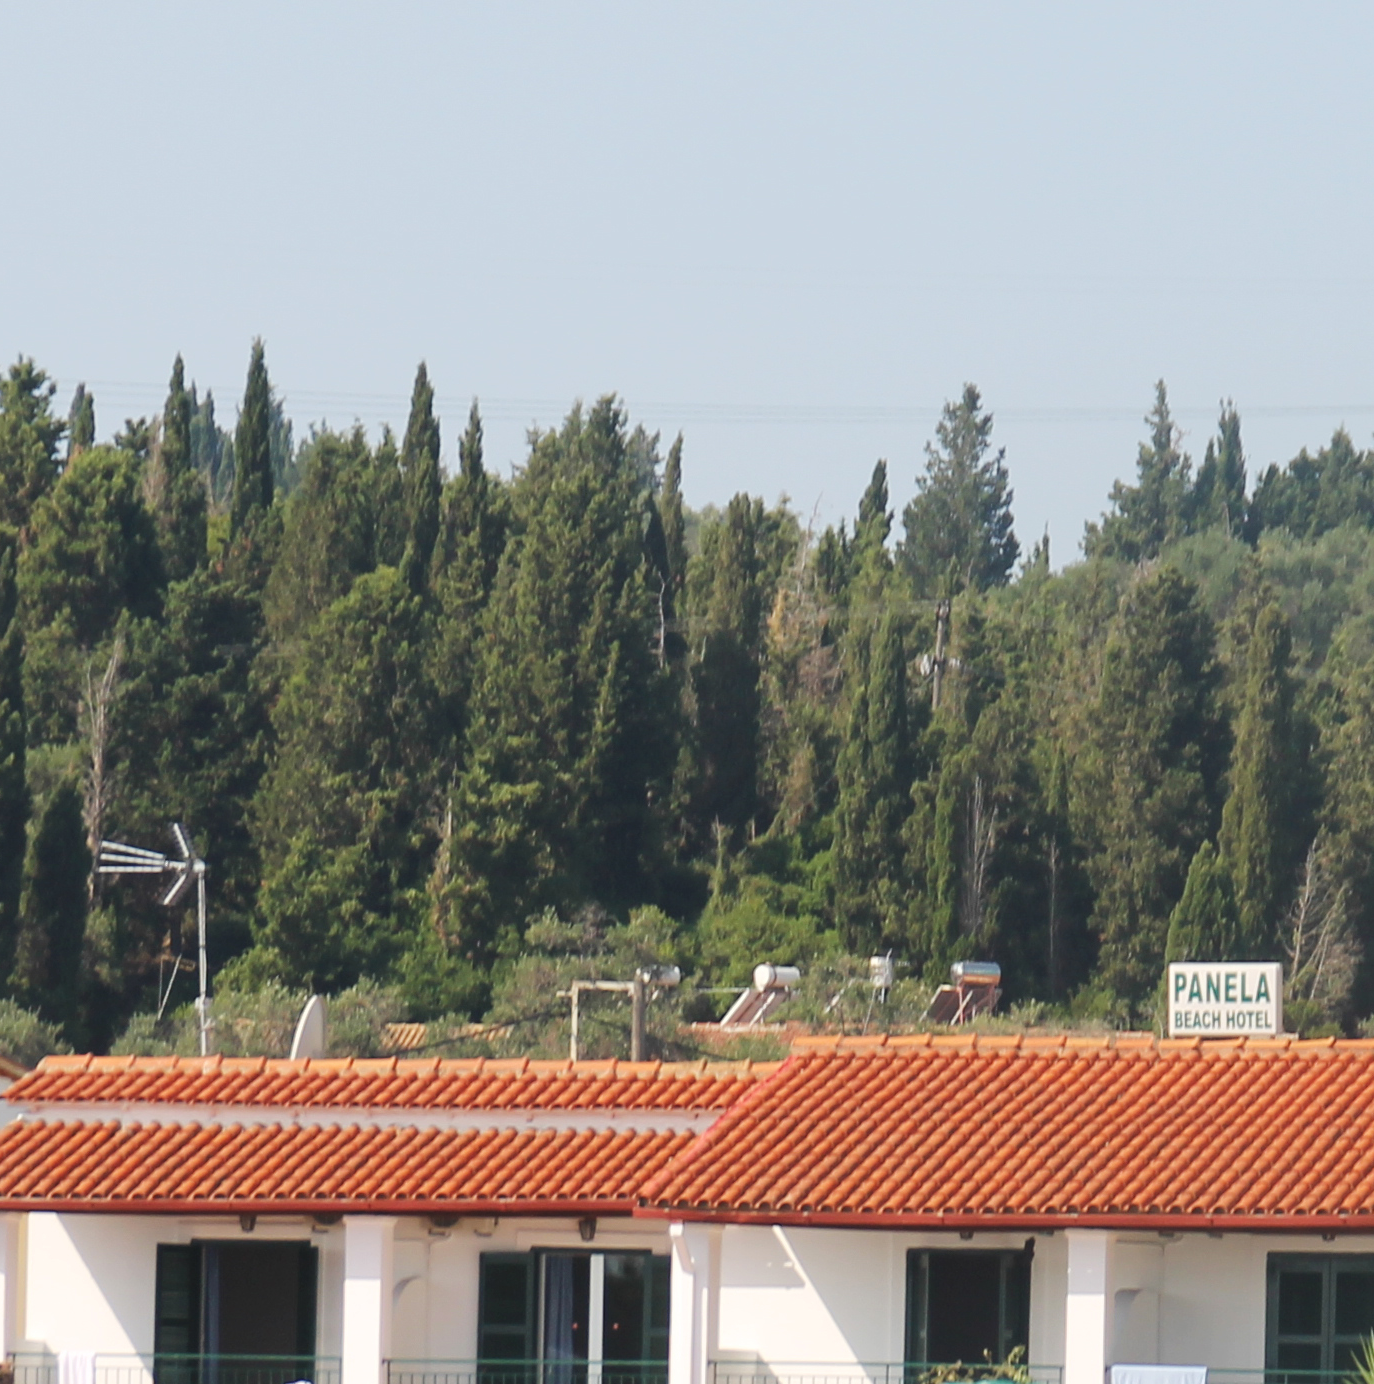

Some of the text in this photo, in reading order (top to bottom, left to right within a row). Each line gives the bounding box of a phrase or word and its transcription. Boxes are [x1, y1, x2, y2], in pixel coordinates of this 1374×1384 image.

[1174, 972, 1270, 1002] PANELA
[1174, 1010, 1272, 1029] BEACH HOTEL
